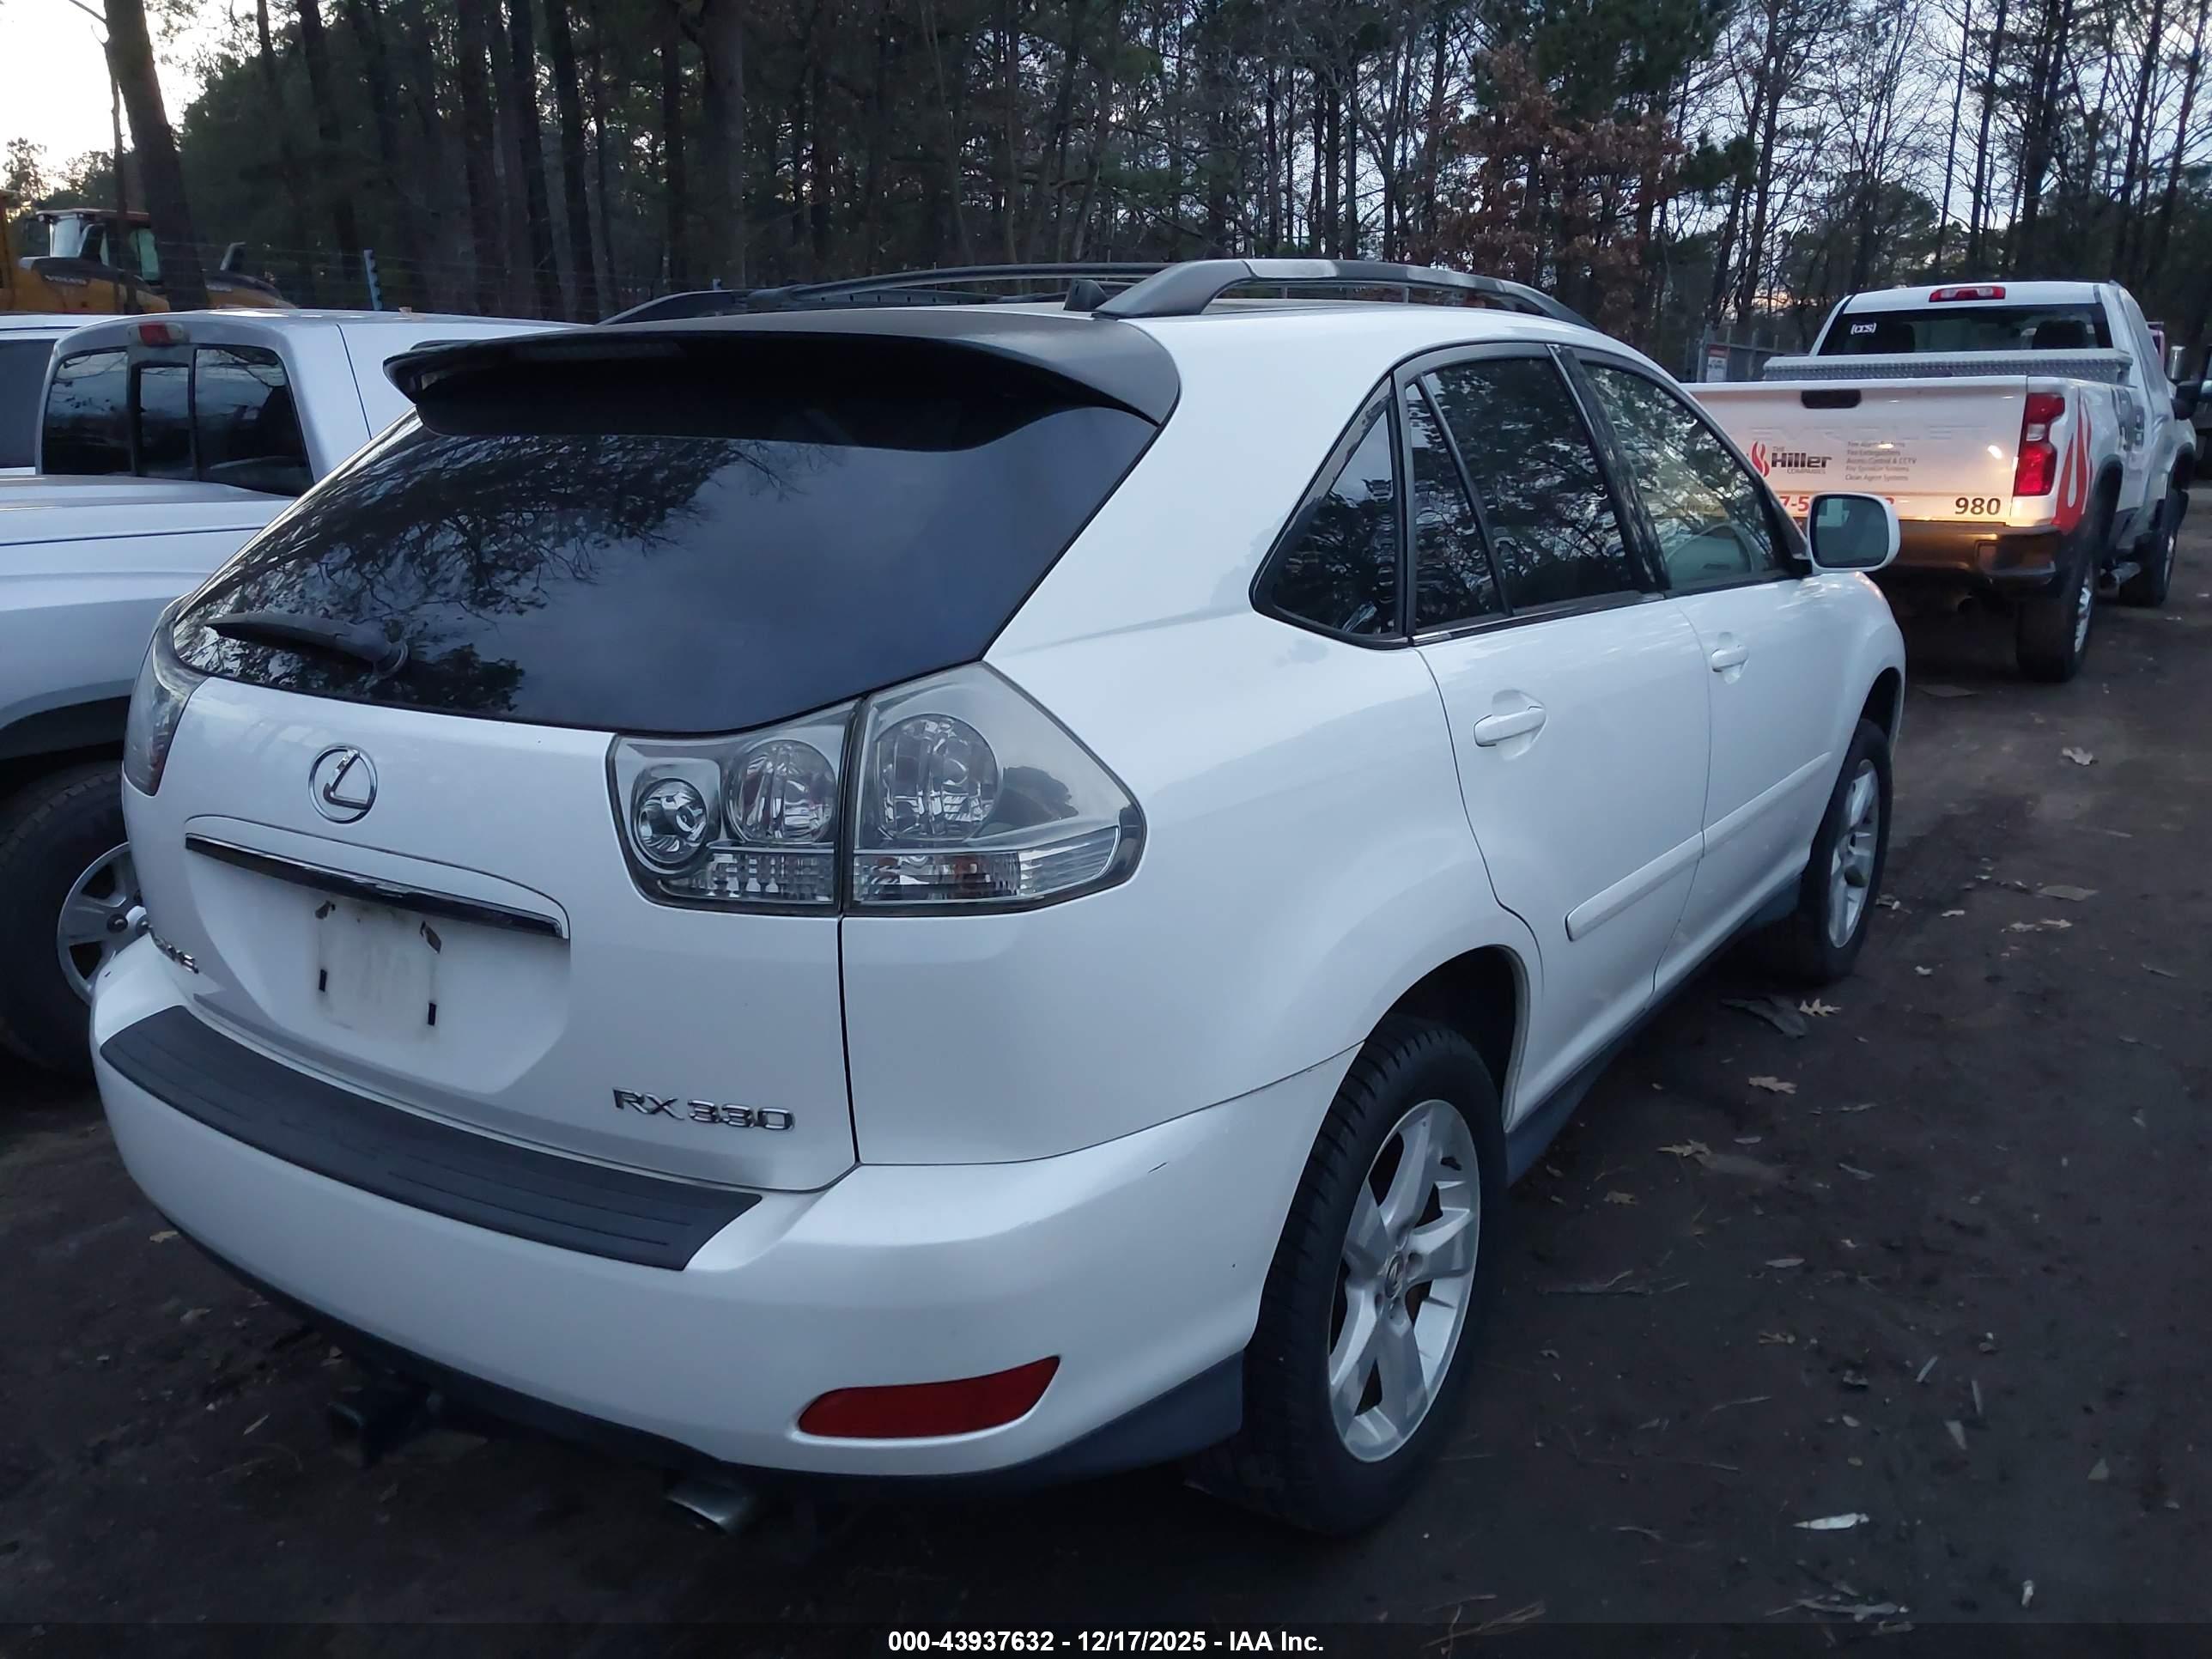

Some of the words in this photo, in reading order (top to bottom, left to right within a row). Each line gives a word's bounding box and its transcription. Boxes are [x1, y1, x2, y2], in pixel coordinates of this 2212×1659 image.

[1771, 452, 1832, 468] Hiller
[1954, 497, 2001, 515] 980
[612, 1086, 685, 1121] RX
[687, 1098, 796, 1131] 330
